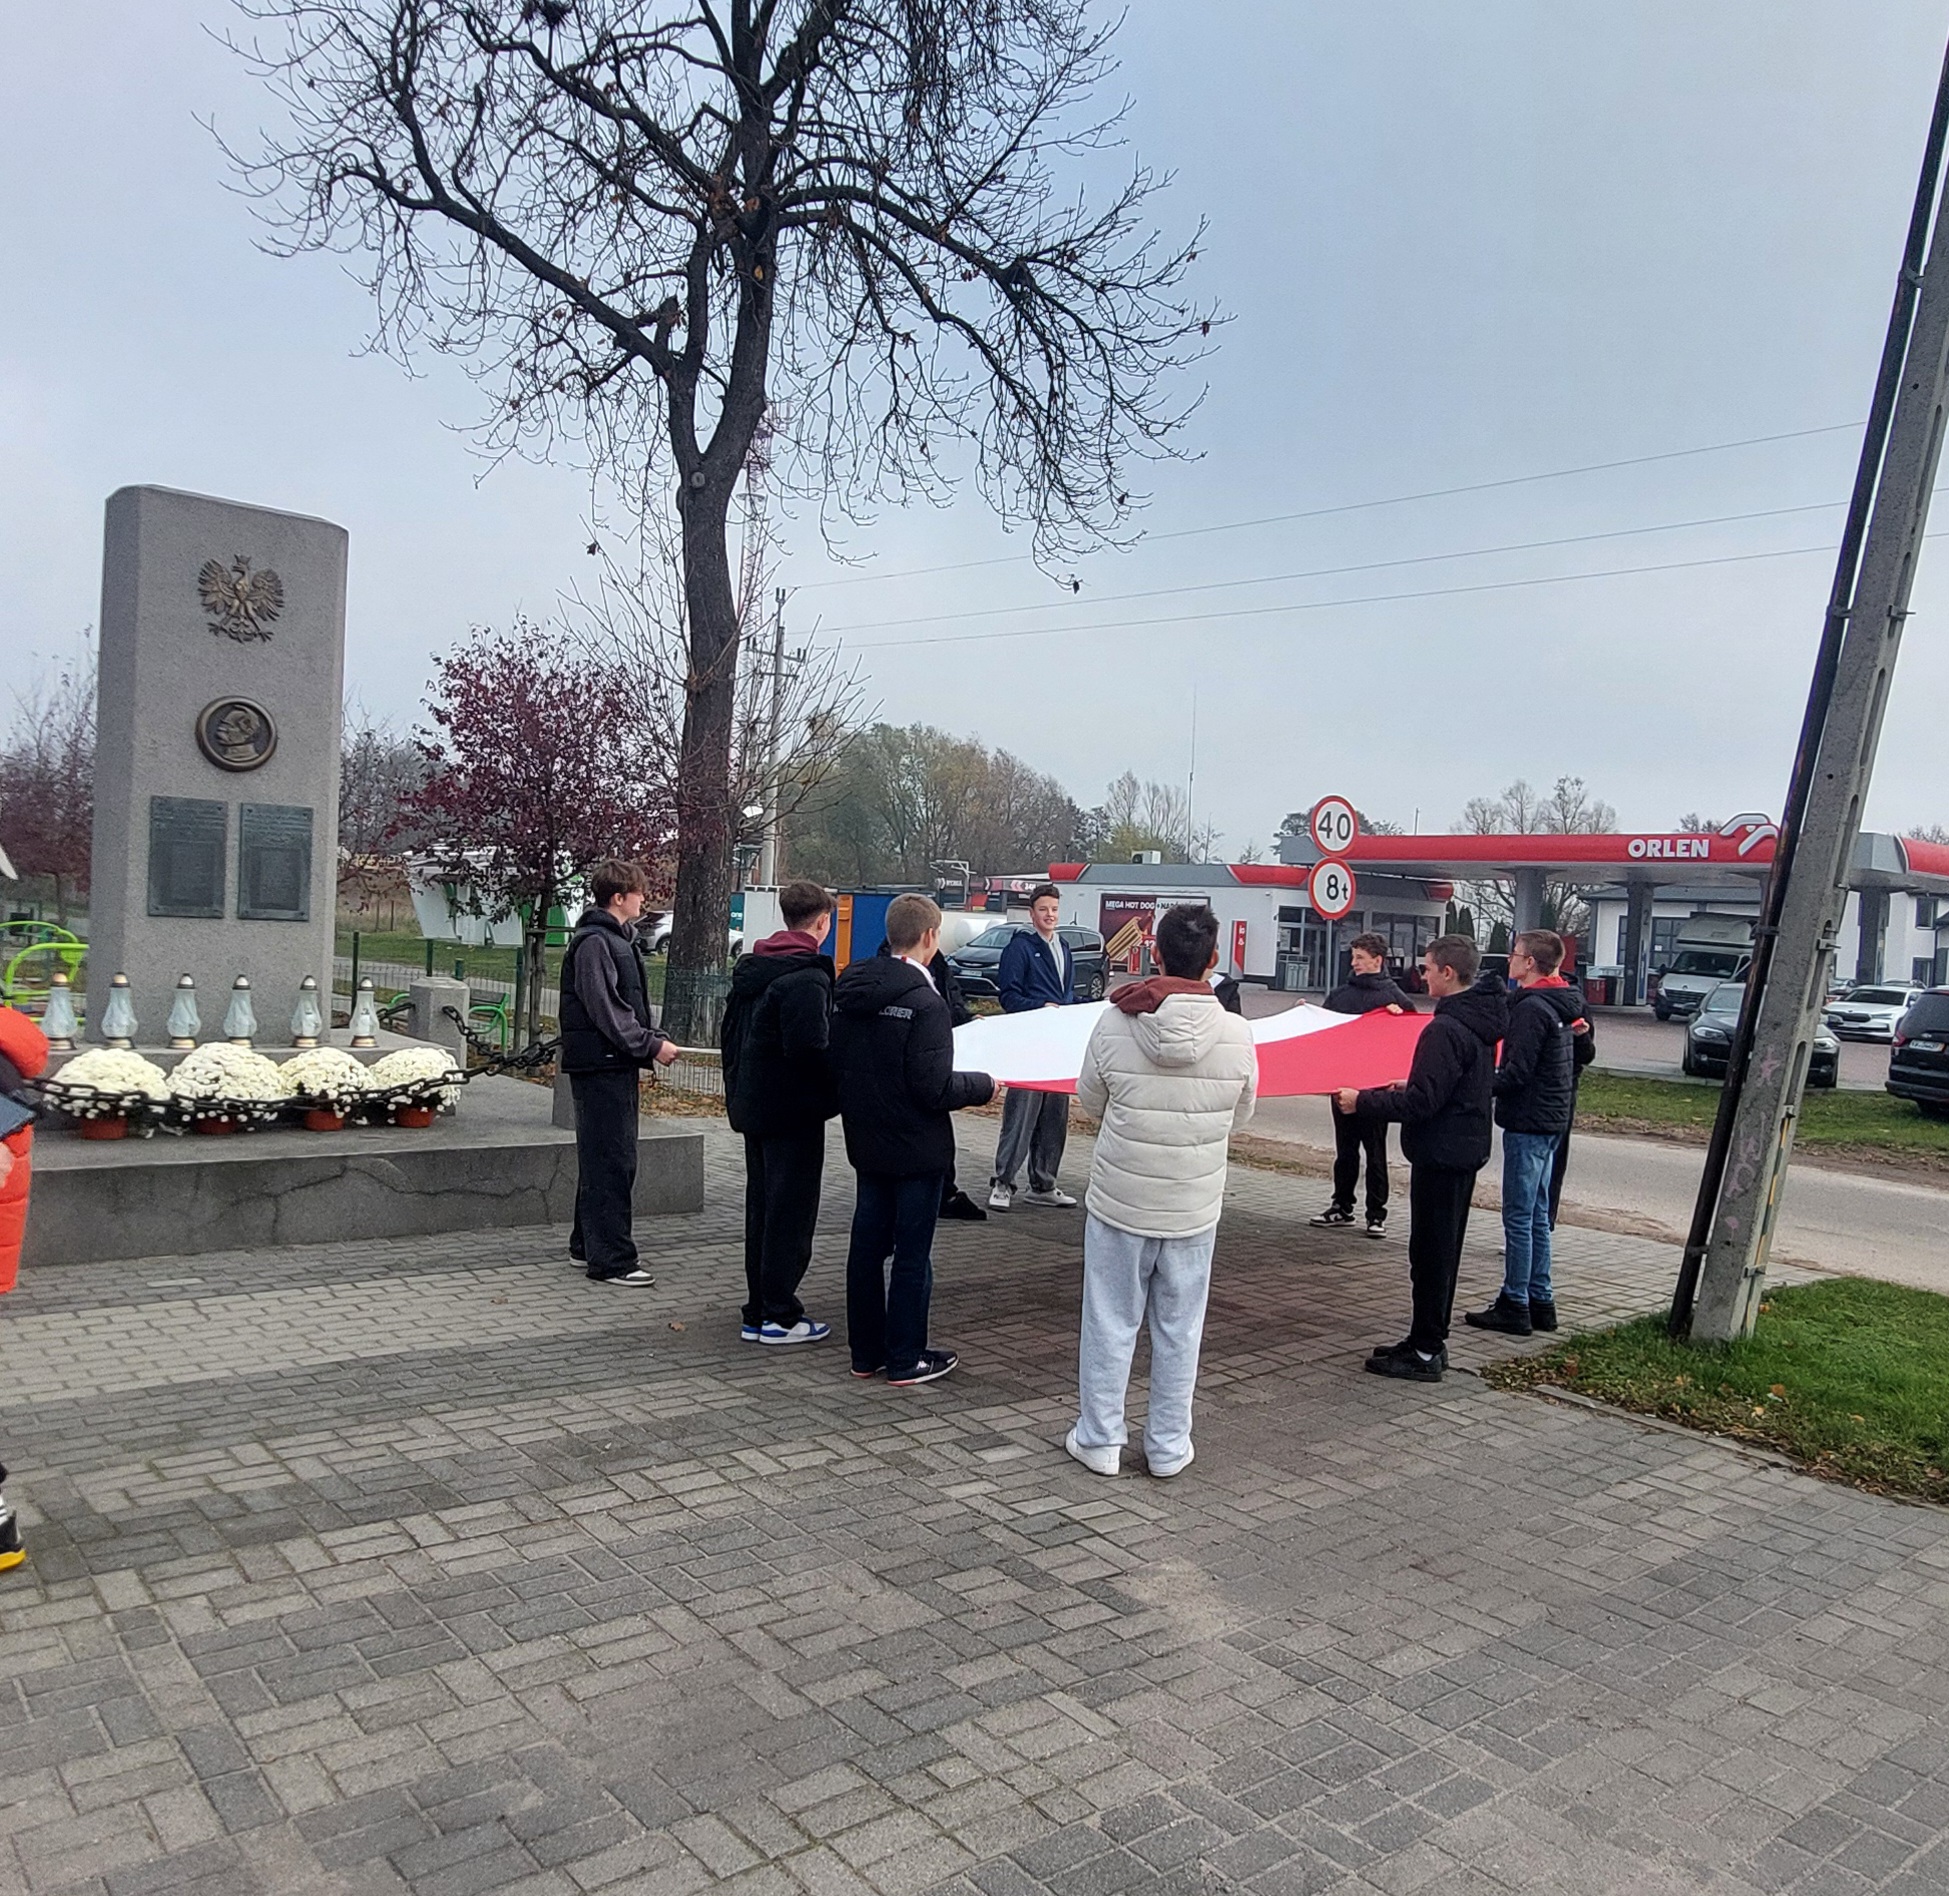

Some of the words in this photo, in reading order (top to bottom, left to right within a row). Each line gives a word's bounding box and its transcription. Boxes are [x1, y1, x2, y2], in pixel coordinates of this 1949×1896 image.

[1318, 811, 1351, 841] 40
[1628, 839, 1710, 858] ORLEN
[1105, 900, 1124, 909] MEGA
[1125, 901, 1139, 909] HOT
[1140, 901, 1155, 910] DOG
